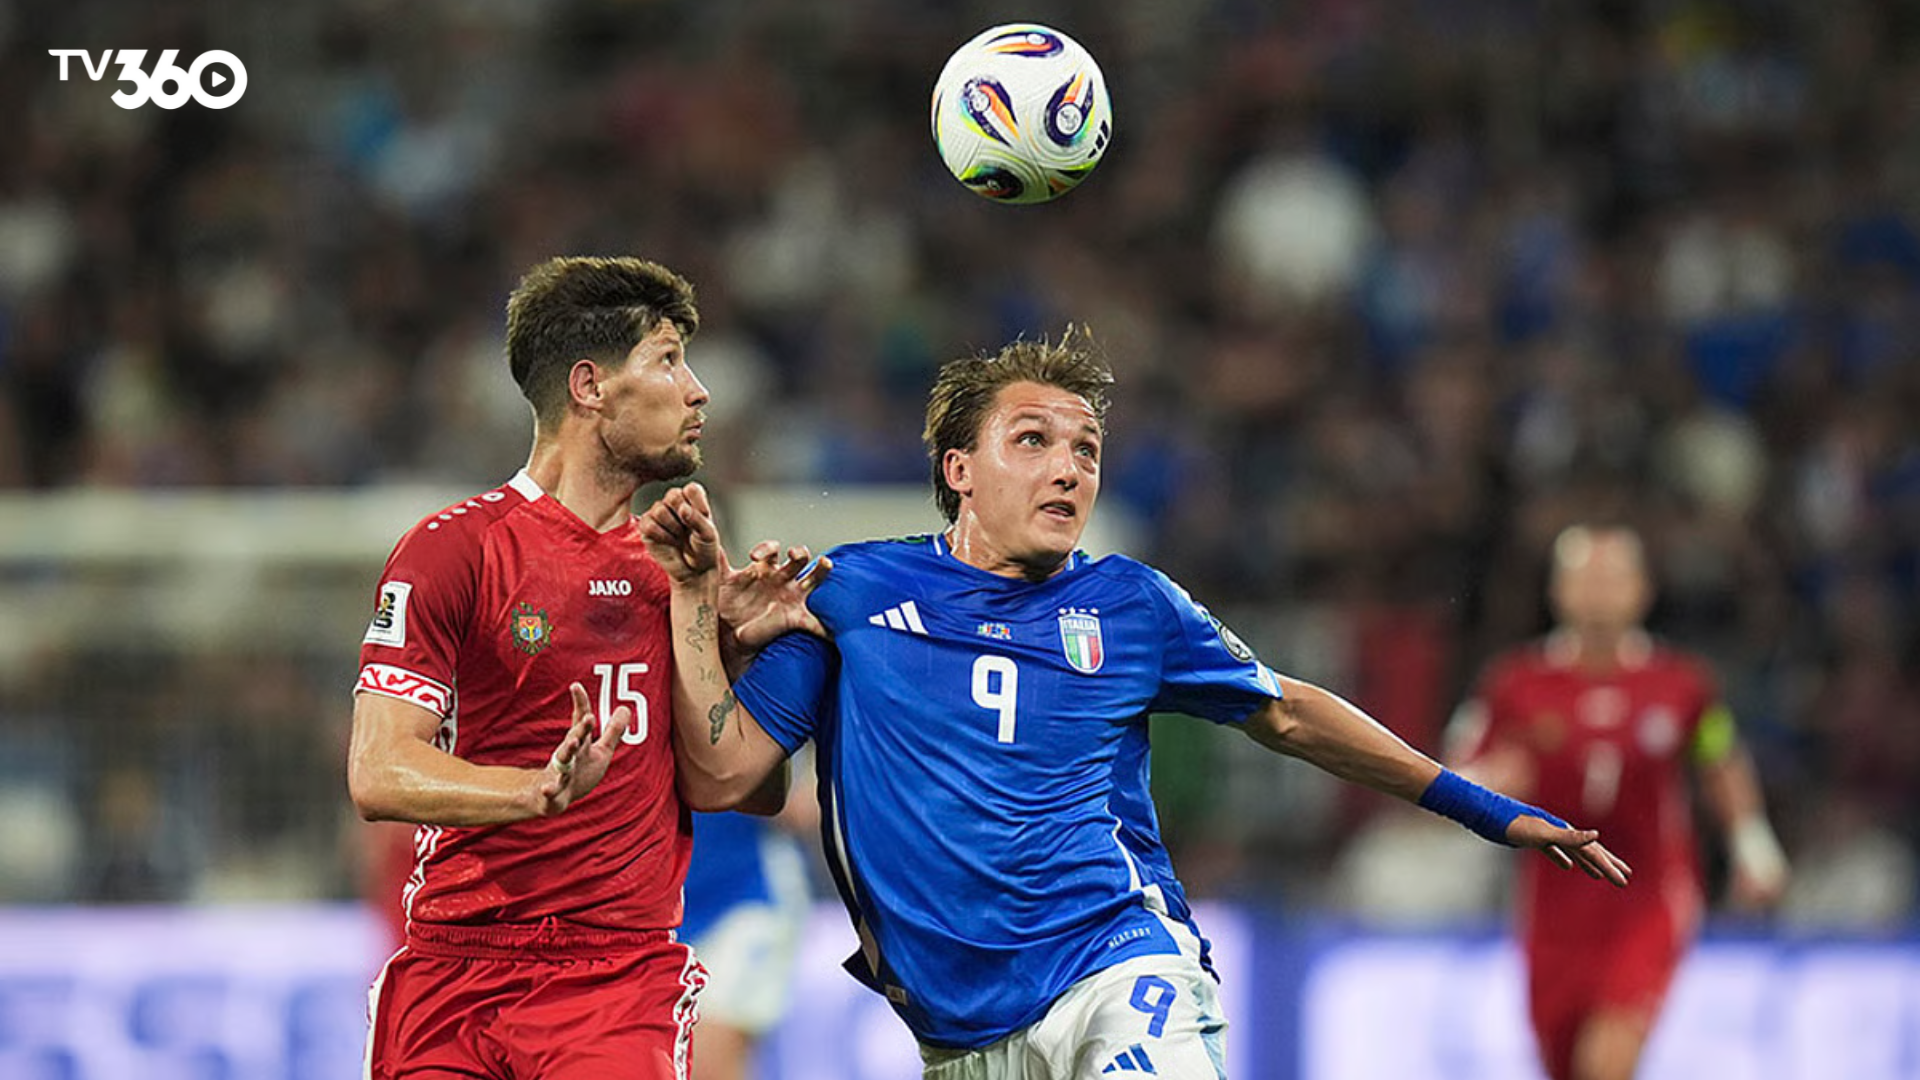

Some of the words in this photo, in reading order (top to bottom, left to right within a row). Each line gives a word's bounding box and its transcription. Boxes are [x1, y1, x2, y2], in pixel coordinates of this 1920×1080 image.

[588, 580, 632, 596] JAKO
[593, 663, 649, 746] 15
[971, 654, 1019, 744] 9
[1129, 974, 1177, 1039] 9
